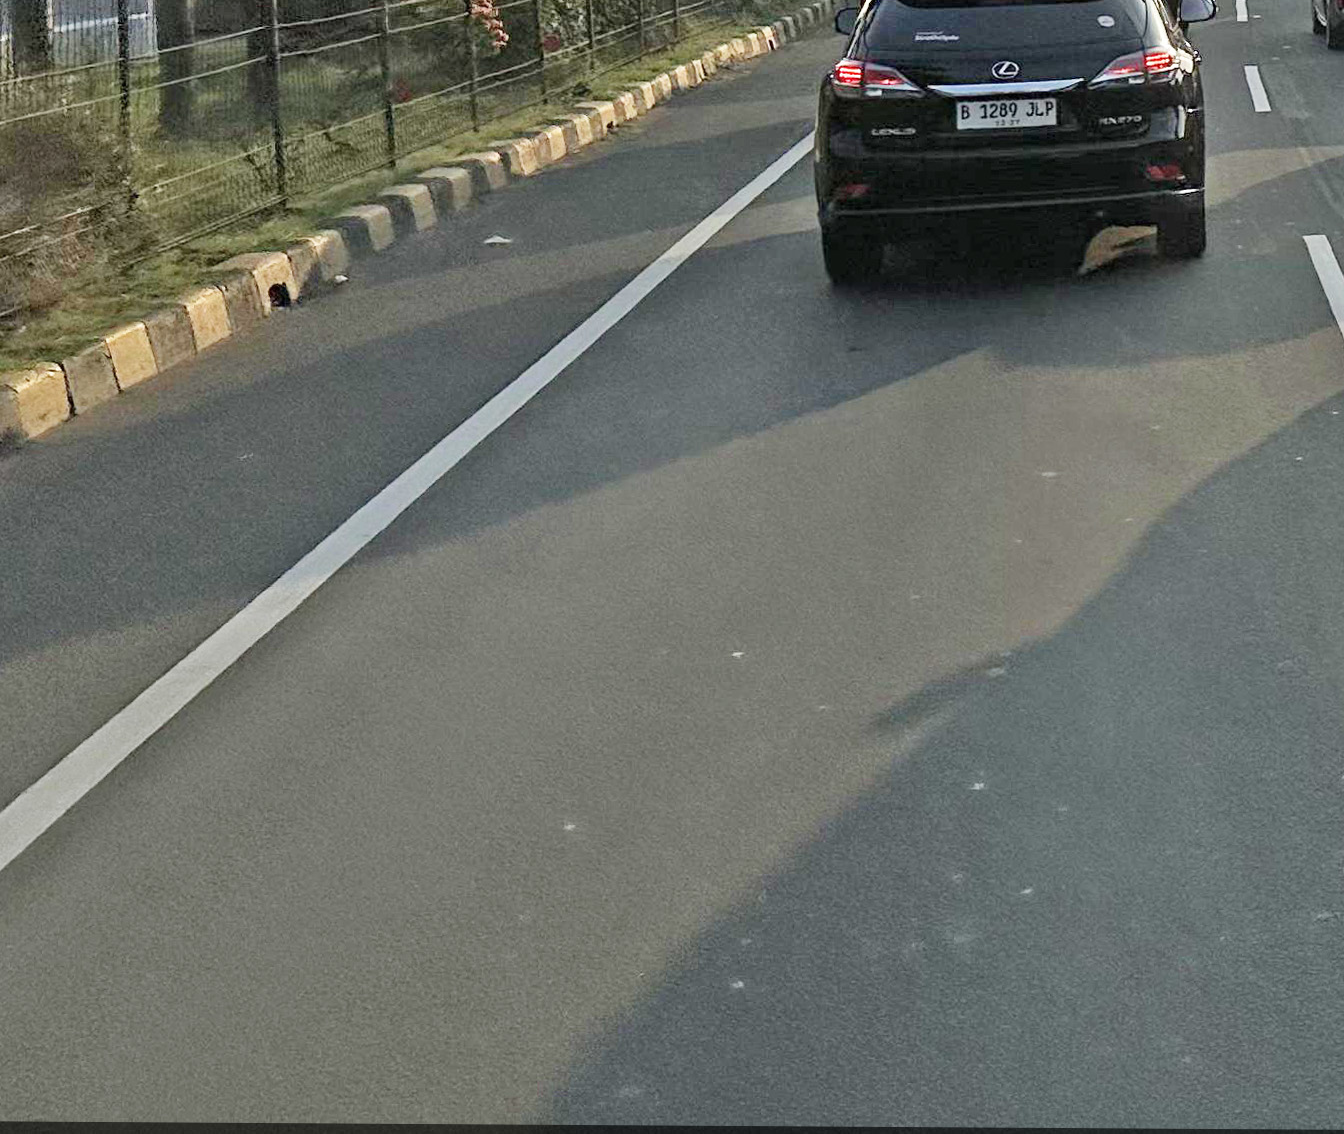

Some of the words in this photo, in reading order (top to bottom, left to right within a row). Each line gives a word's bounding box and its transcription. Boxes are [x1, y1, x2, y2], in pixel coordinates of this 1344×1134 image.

[961, 105, 971, 120] B
[979, 102, 1018, 119] 1289
[1026, 101, 1054, 117] JLP
